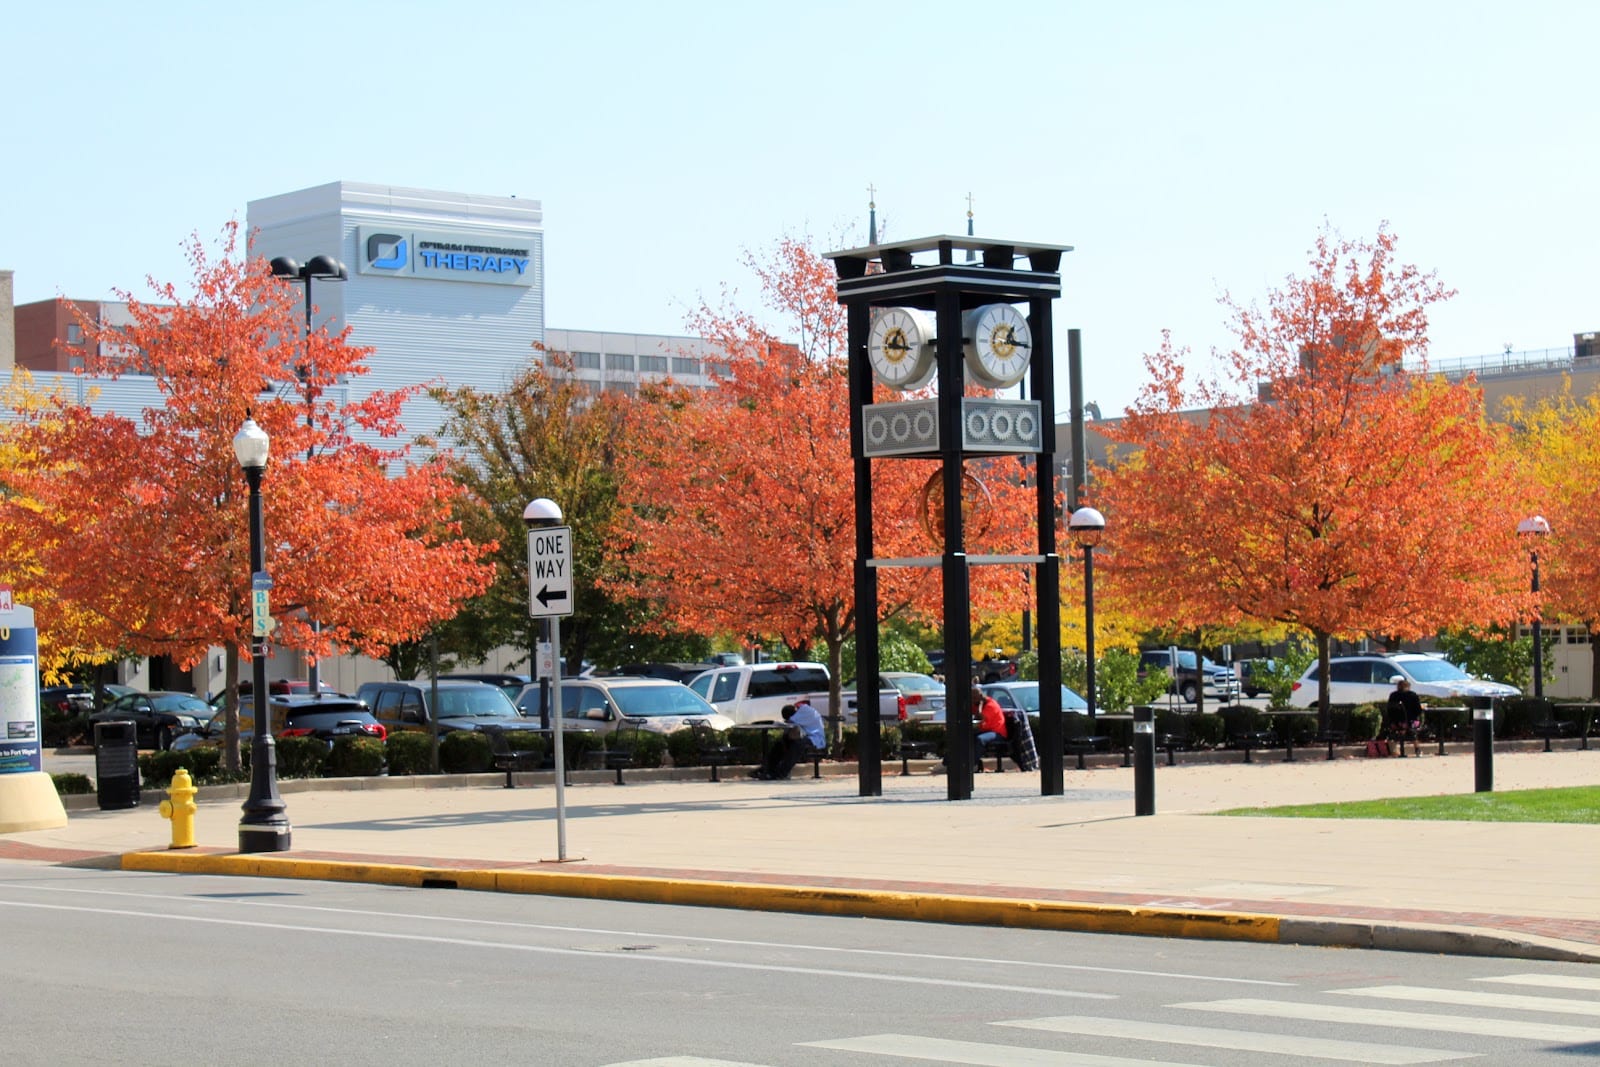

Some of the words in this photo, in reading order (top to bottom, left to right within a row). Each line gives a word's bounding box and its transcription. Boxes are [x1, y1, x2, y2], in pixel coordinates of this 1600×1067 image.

[420, 250, 529, 275] THERAPY
[536, 536, 564, 556] ONE
[536, 558, 565, 579] WAY
[256, 592, 266, 630] BUS
